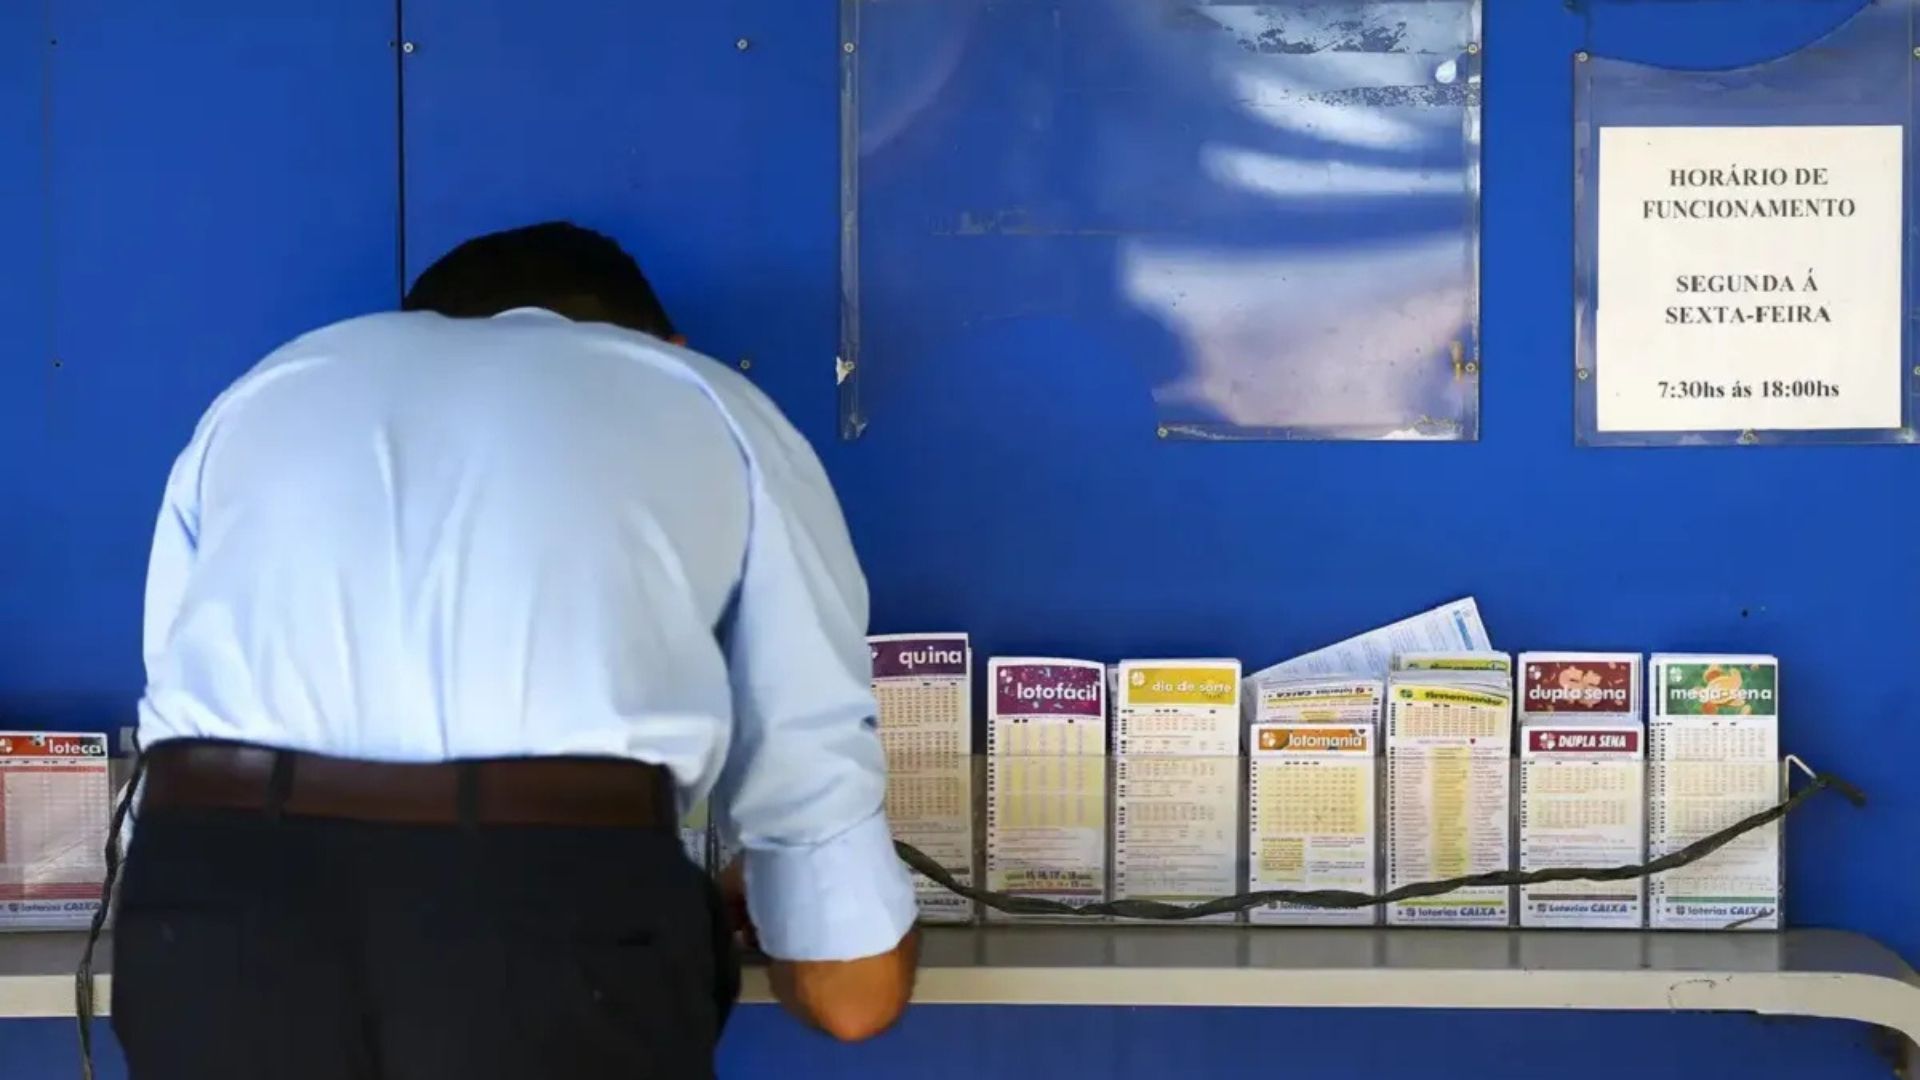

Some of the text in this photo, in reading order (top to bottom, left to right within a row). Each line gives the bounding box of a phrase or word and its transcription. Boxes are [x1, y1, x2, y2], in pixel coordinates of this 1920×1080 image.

[1669, 164, 1828, 186] HORÁRIO DE
[1643, 198, 1856, 219] FUNCIONAMENTO
[1676, 268, 1818, 293] SEGUNDA Á
[1665, 306, 1831, 324] SEXTA-FEIRA
[1657, 380, 1839, 398] 7:30hs ás 18:00hs
[899, 645, 963, 669] quina
[1016, 682, 1098, 701] lotofácil
[1152, 679, 1232, 693] dia de sorte
[1529, 685, 1626, 703] dupla sena
[1670, 687, 1772, 703] mega-sena
[48, 738, 101, 754] loteca
[1288, 733, 1363, 747] lotomania
[1558, 735, 1627, 748] DUPLA SENA
[1460, 907, 1497, 917] CAIXA
[1590, 903, 1628, 913] CAIXA
